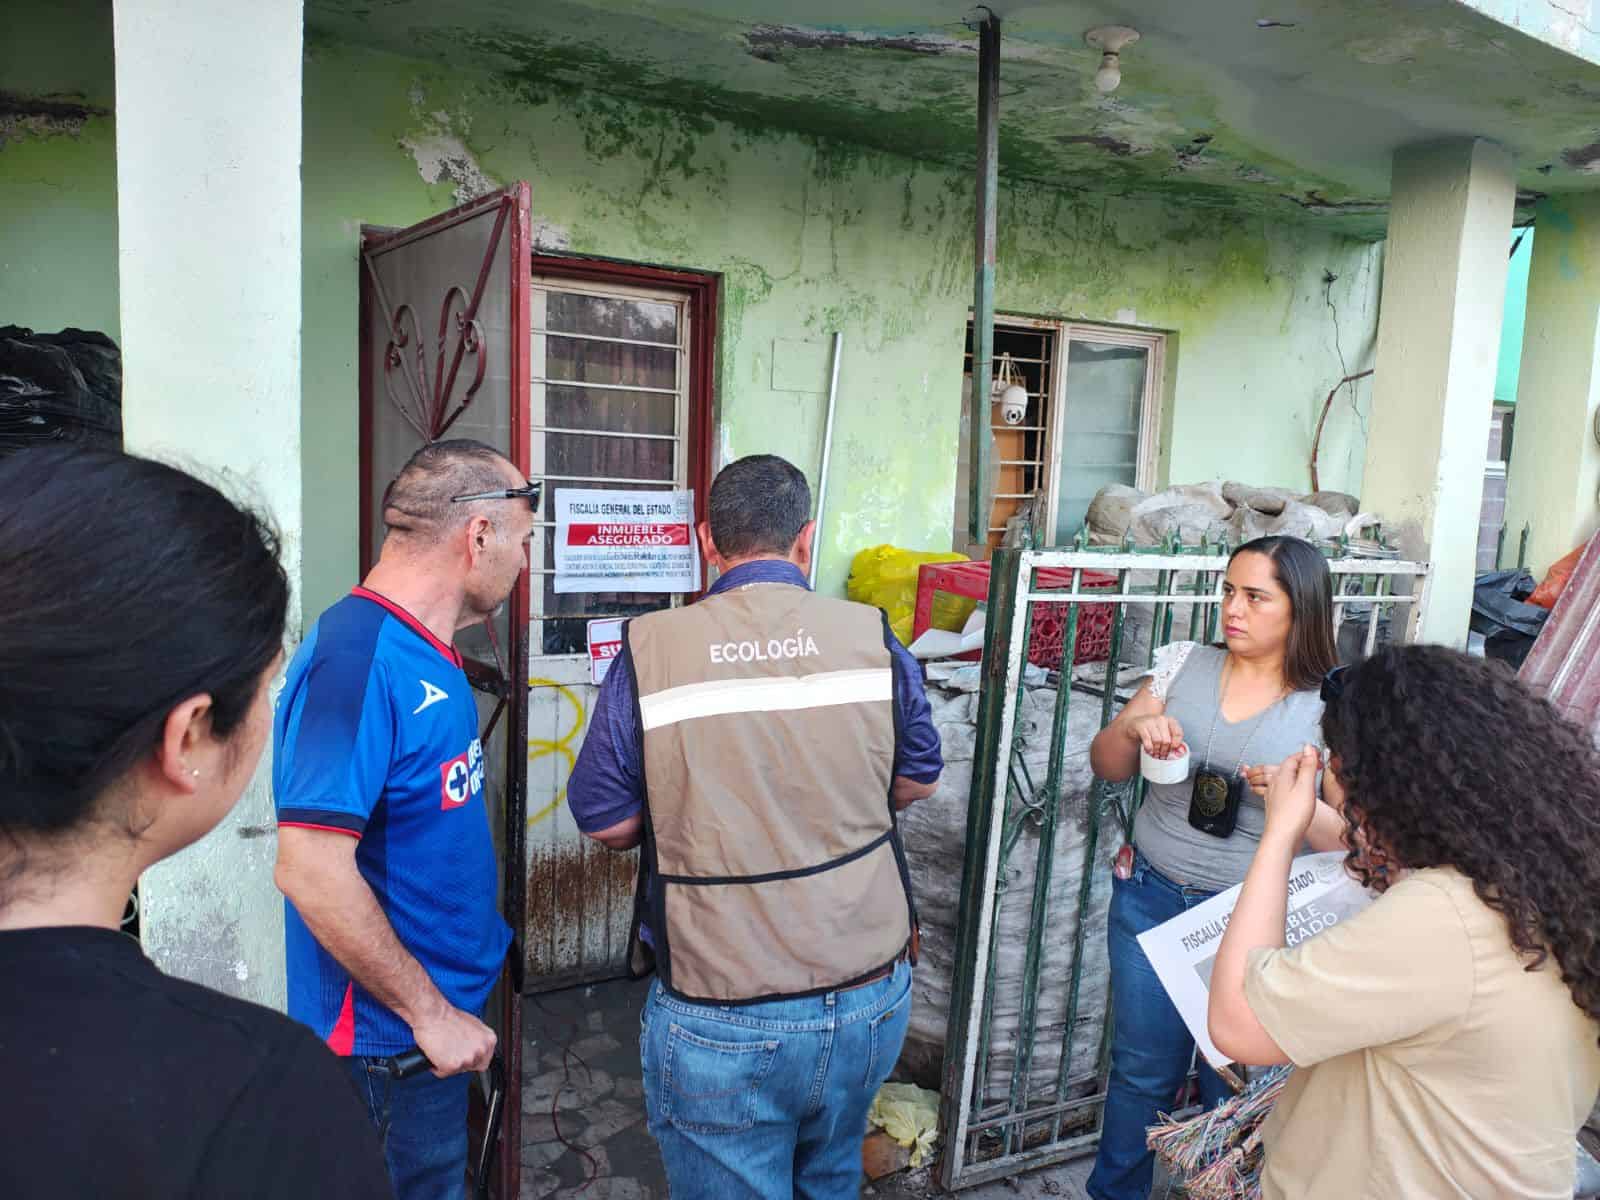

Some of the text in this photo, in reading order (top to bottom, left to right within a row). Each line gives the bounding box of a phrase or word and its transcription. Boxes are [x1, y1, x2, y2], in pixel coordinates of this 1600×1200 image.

[601, 503, 630, 515] GENERAL
[632, 504, 645, 516] DEL
[646, 504, 672, 516] ESTADO
[587, 534, 673, 545] ASEGURADO
[597, 524, 665, 535] INMUEBLE
[600, 643, 622, 657] SU
[709, 628, 820, 663] ECOLOGÍA
[1287, 869, 1315, 897] STADO
[1286, 902, 1321, 932] BLE
[1285, 911, 1338, 947] RADO
